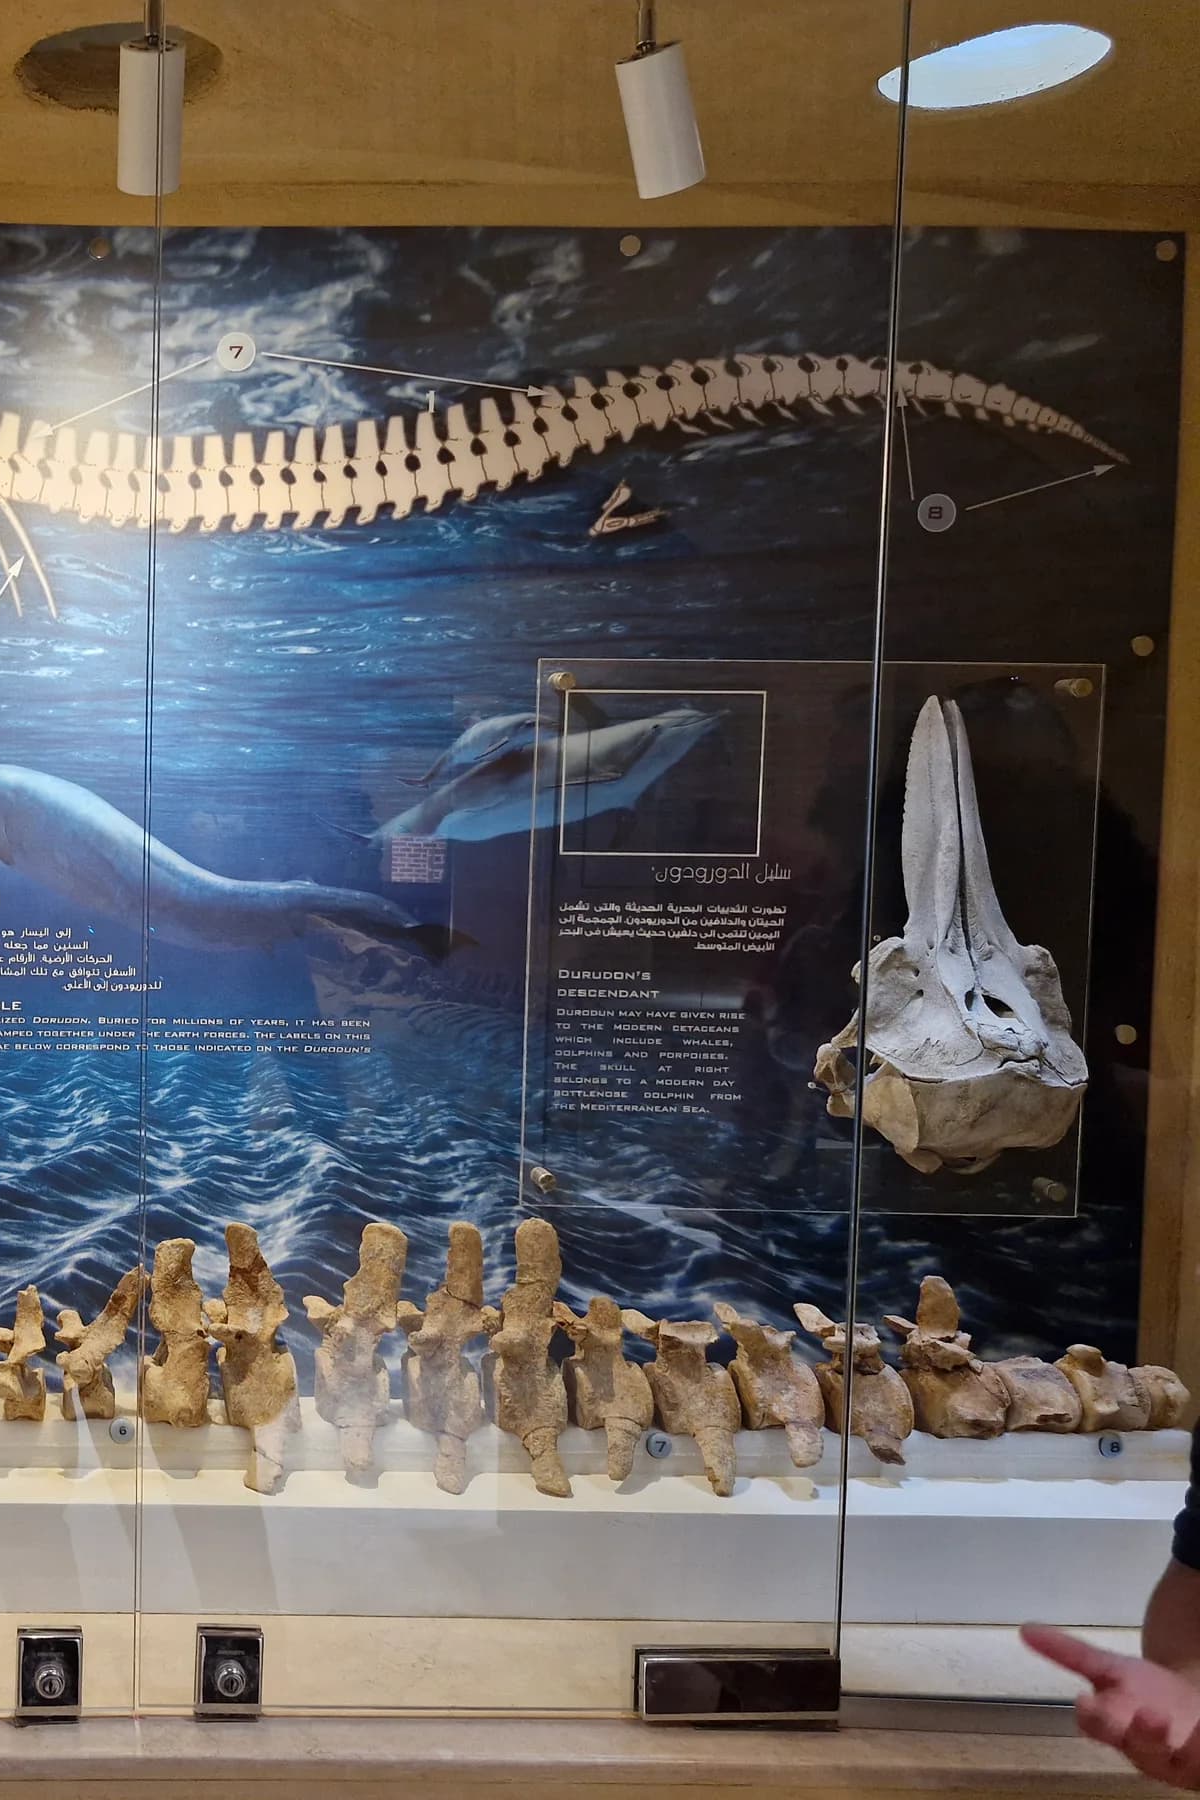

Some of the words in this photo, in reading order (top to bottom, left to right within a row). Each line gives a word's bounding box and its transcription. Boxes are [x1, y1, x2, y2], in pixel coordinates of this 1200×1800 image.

[229, 345, 243, 359] 7
[928, 507, 942, 518] 8
[119, 1426, 126, 1435] 6
[656, 1442, 666, 1452] 7
[1111, 1443, 1119, 1452] 8
